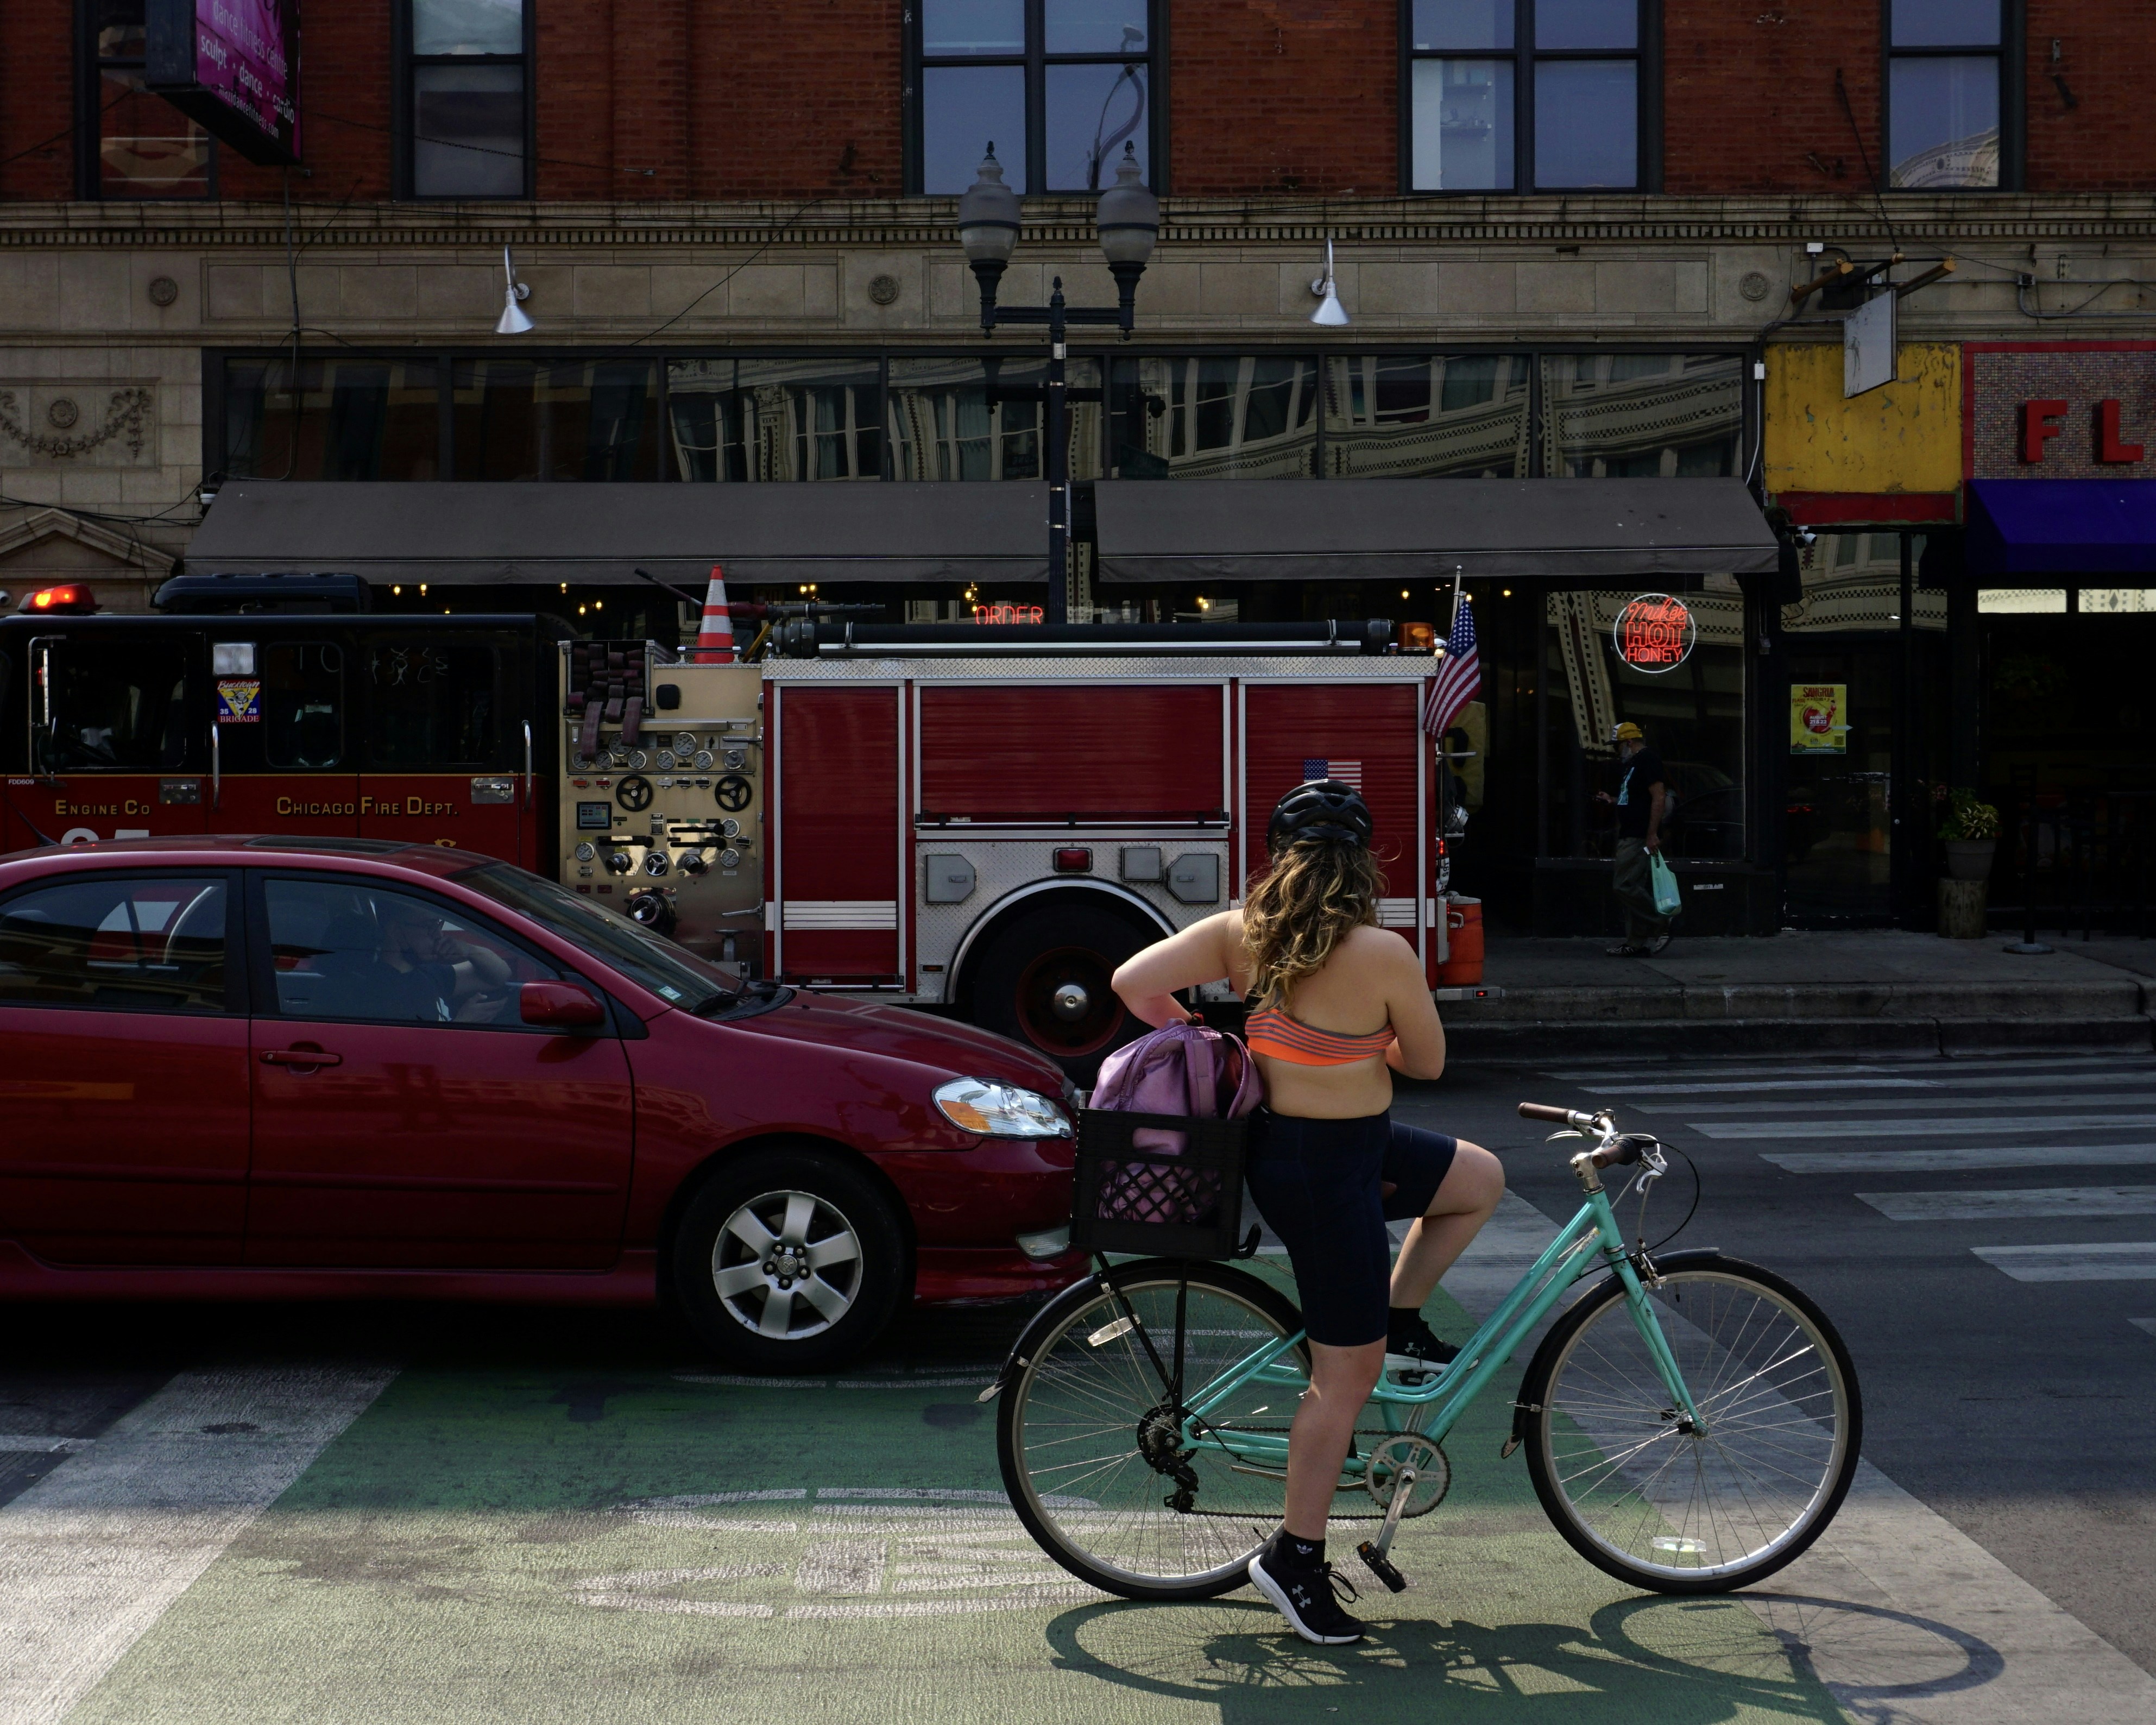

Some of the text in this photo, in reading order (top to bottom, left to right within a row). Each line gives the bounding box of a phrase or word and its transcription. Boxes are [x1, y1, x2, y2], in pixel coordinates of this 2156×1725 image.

[213, 1, 288, 80] dance fitness centre
[200, 34, 295, 125] sculpt dance cardio
[975, 605, 1043, 625] ORDER
[1626, 621, 1687, 647] HOT
[1627, 647, 1684, 663] HONEY
[217, 680, 261, 691] Bucktown
[1803, 687, 1835, 697] SANGRIA
[220, 715, 260, 723] BRIGADE
